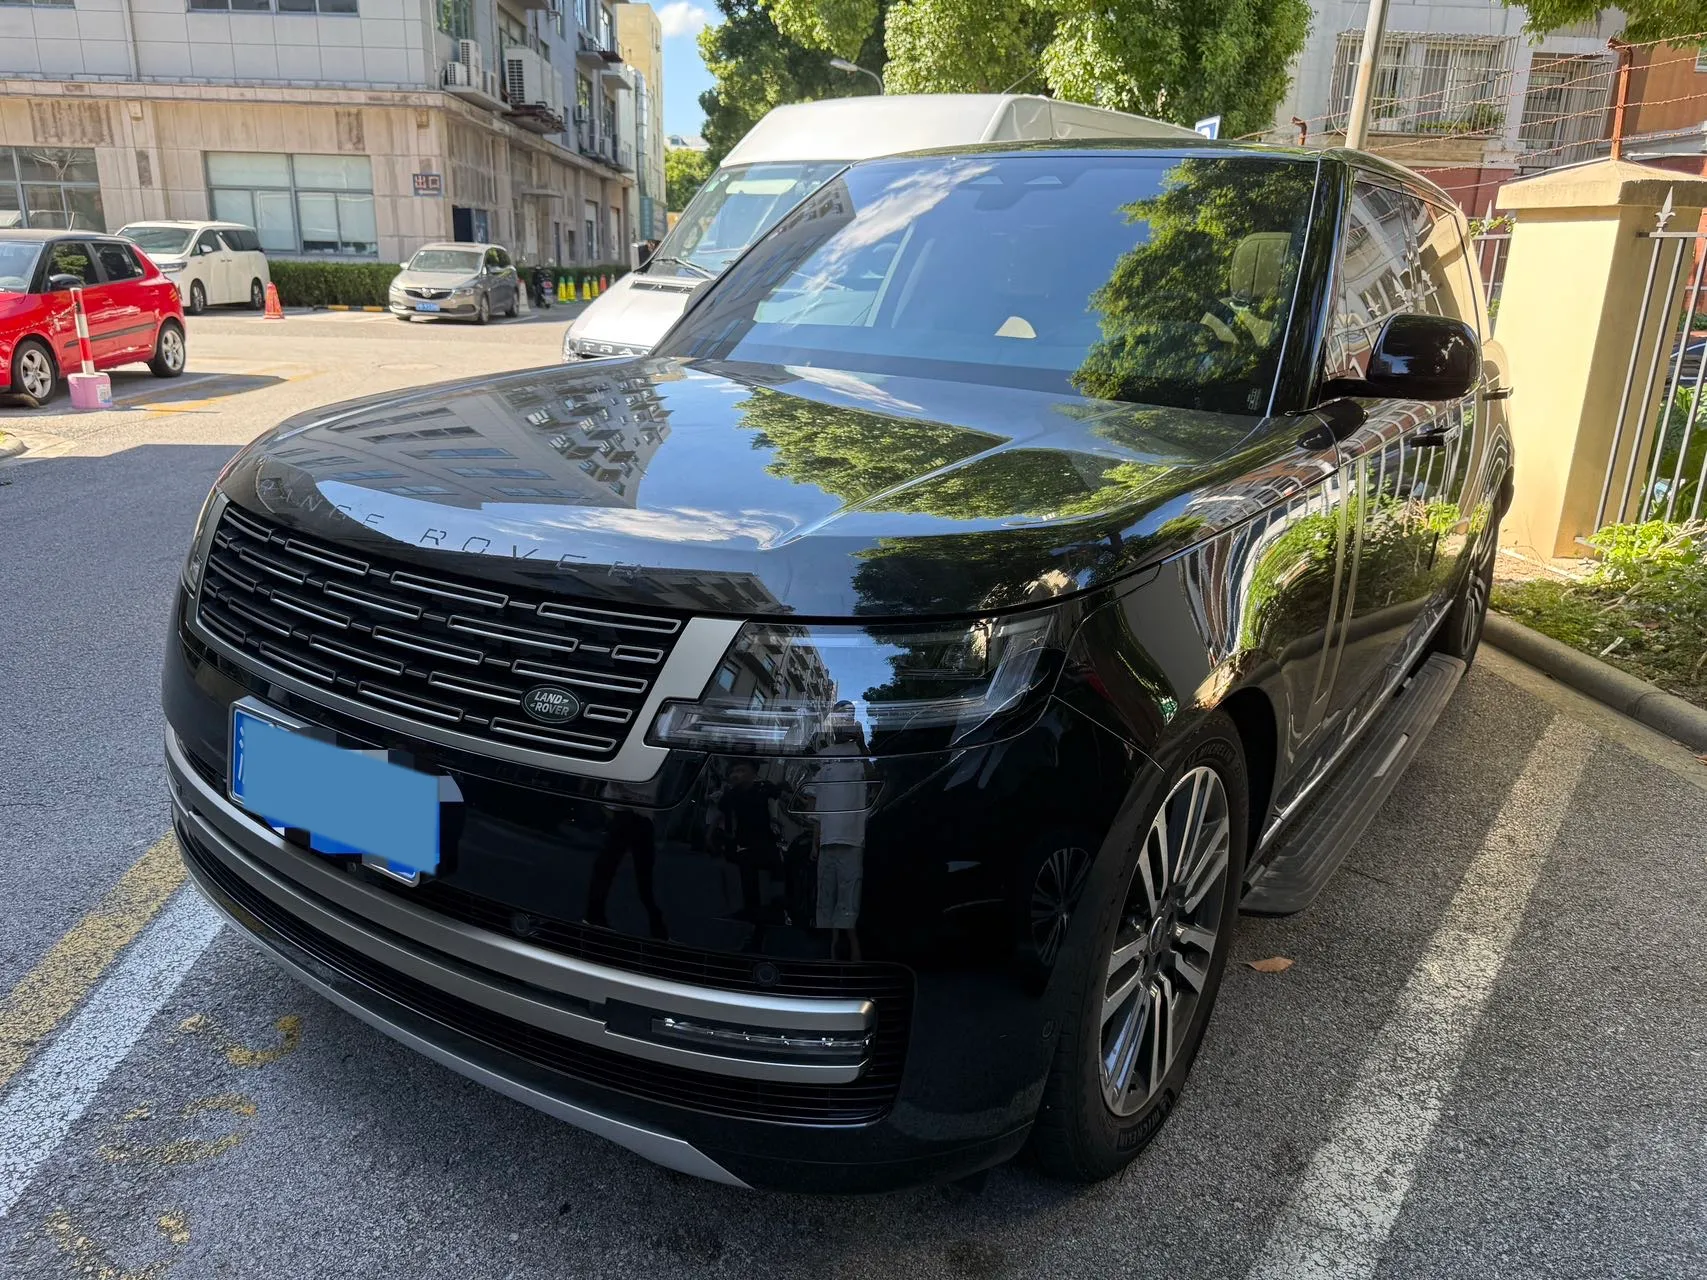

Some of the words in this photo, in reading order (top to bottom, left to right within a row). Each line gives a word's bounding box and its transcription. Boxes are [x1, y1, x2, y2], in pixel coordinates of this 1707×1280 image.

[415, 175, 440, 189] 出口
[534, 691, 563, 704] LAND
[535, 702, 570, 716] ROVER
